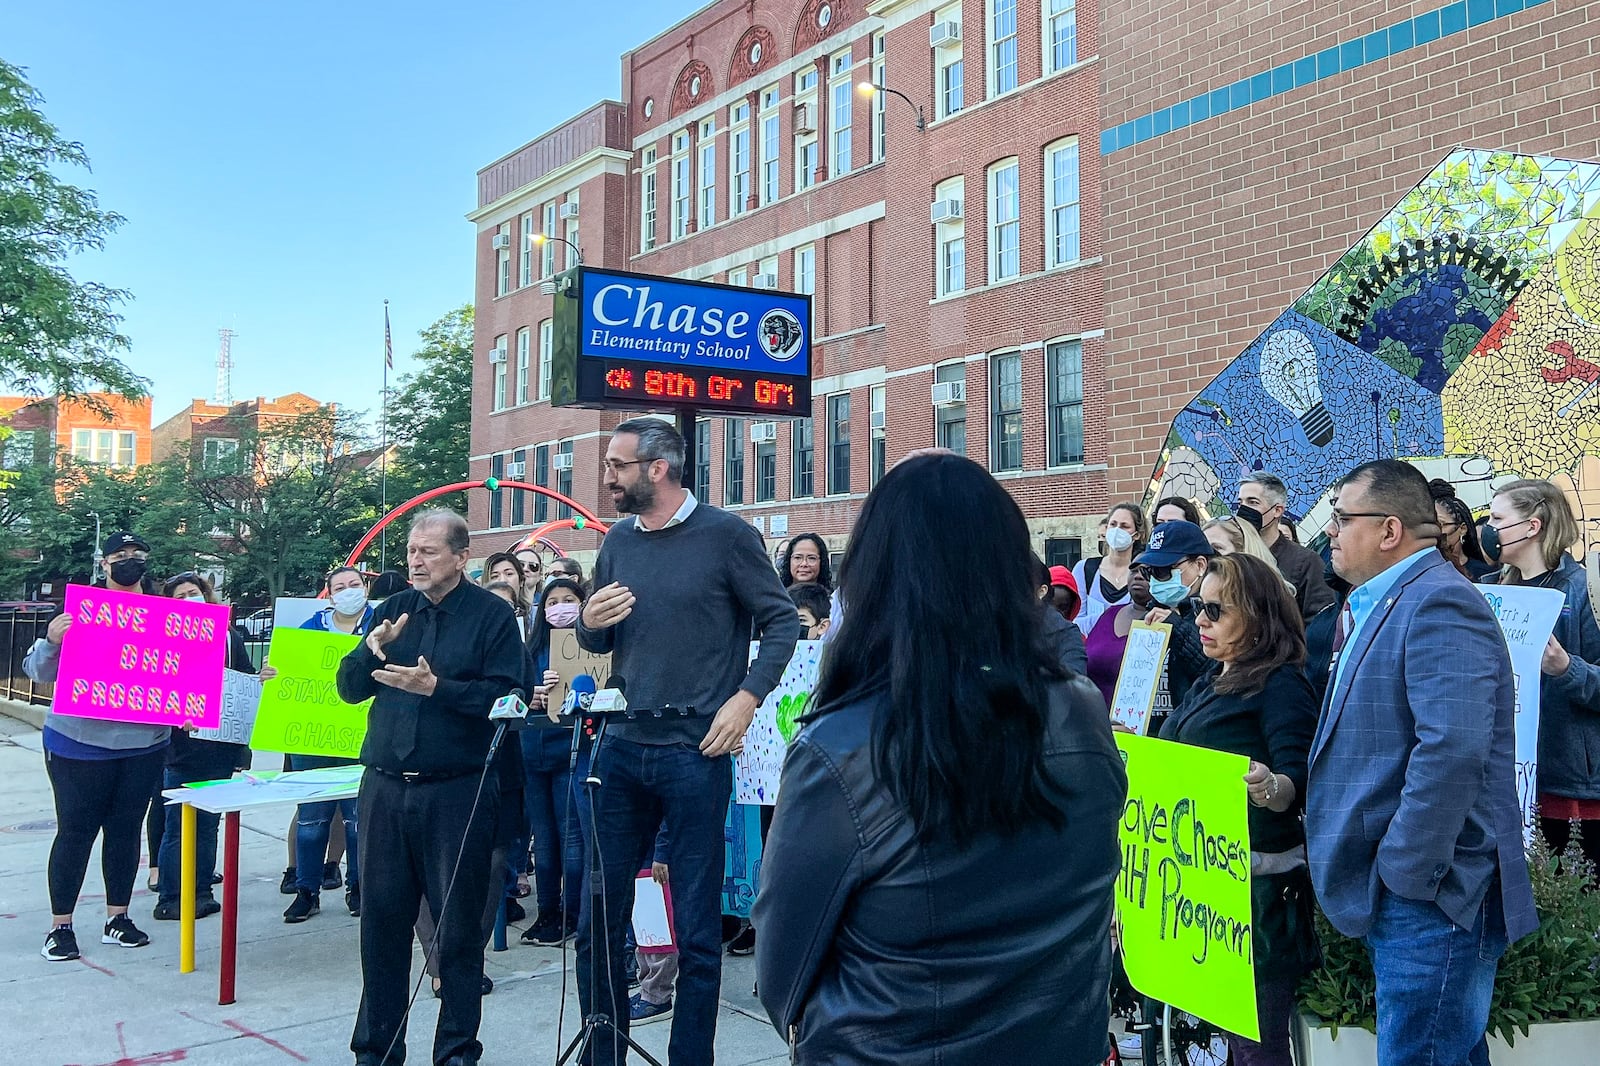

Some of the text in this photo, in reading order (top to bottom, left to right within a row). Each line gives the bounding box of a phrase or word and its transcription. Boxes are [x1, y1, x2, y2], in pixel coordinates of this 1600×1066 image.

[592, 284, 749, 339] Chase
[590, 329, 751, 361] Elementary School
[708, 375, 743, 400] Gr
[78, 599, 215, 643] SAVE OUR
[1522, 612, 1530, 624] A
[120, 644, 180, 675] DHH
[72, 678, 207, 718] PROGRAM
[220, 693, 250, 719] EAF
[278, 677, 340, 706] STAYS
[285, 721, 365, 753] CHASE
[1121, 795, 1167, 844] ave
[1118, 839, 1150, 909] HH
[1159, 856, 1252, 965] Program
